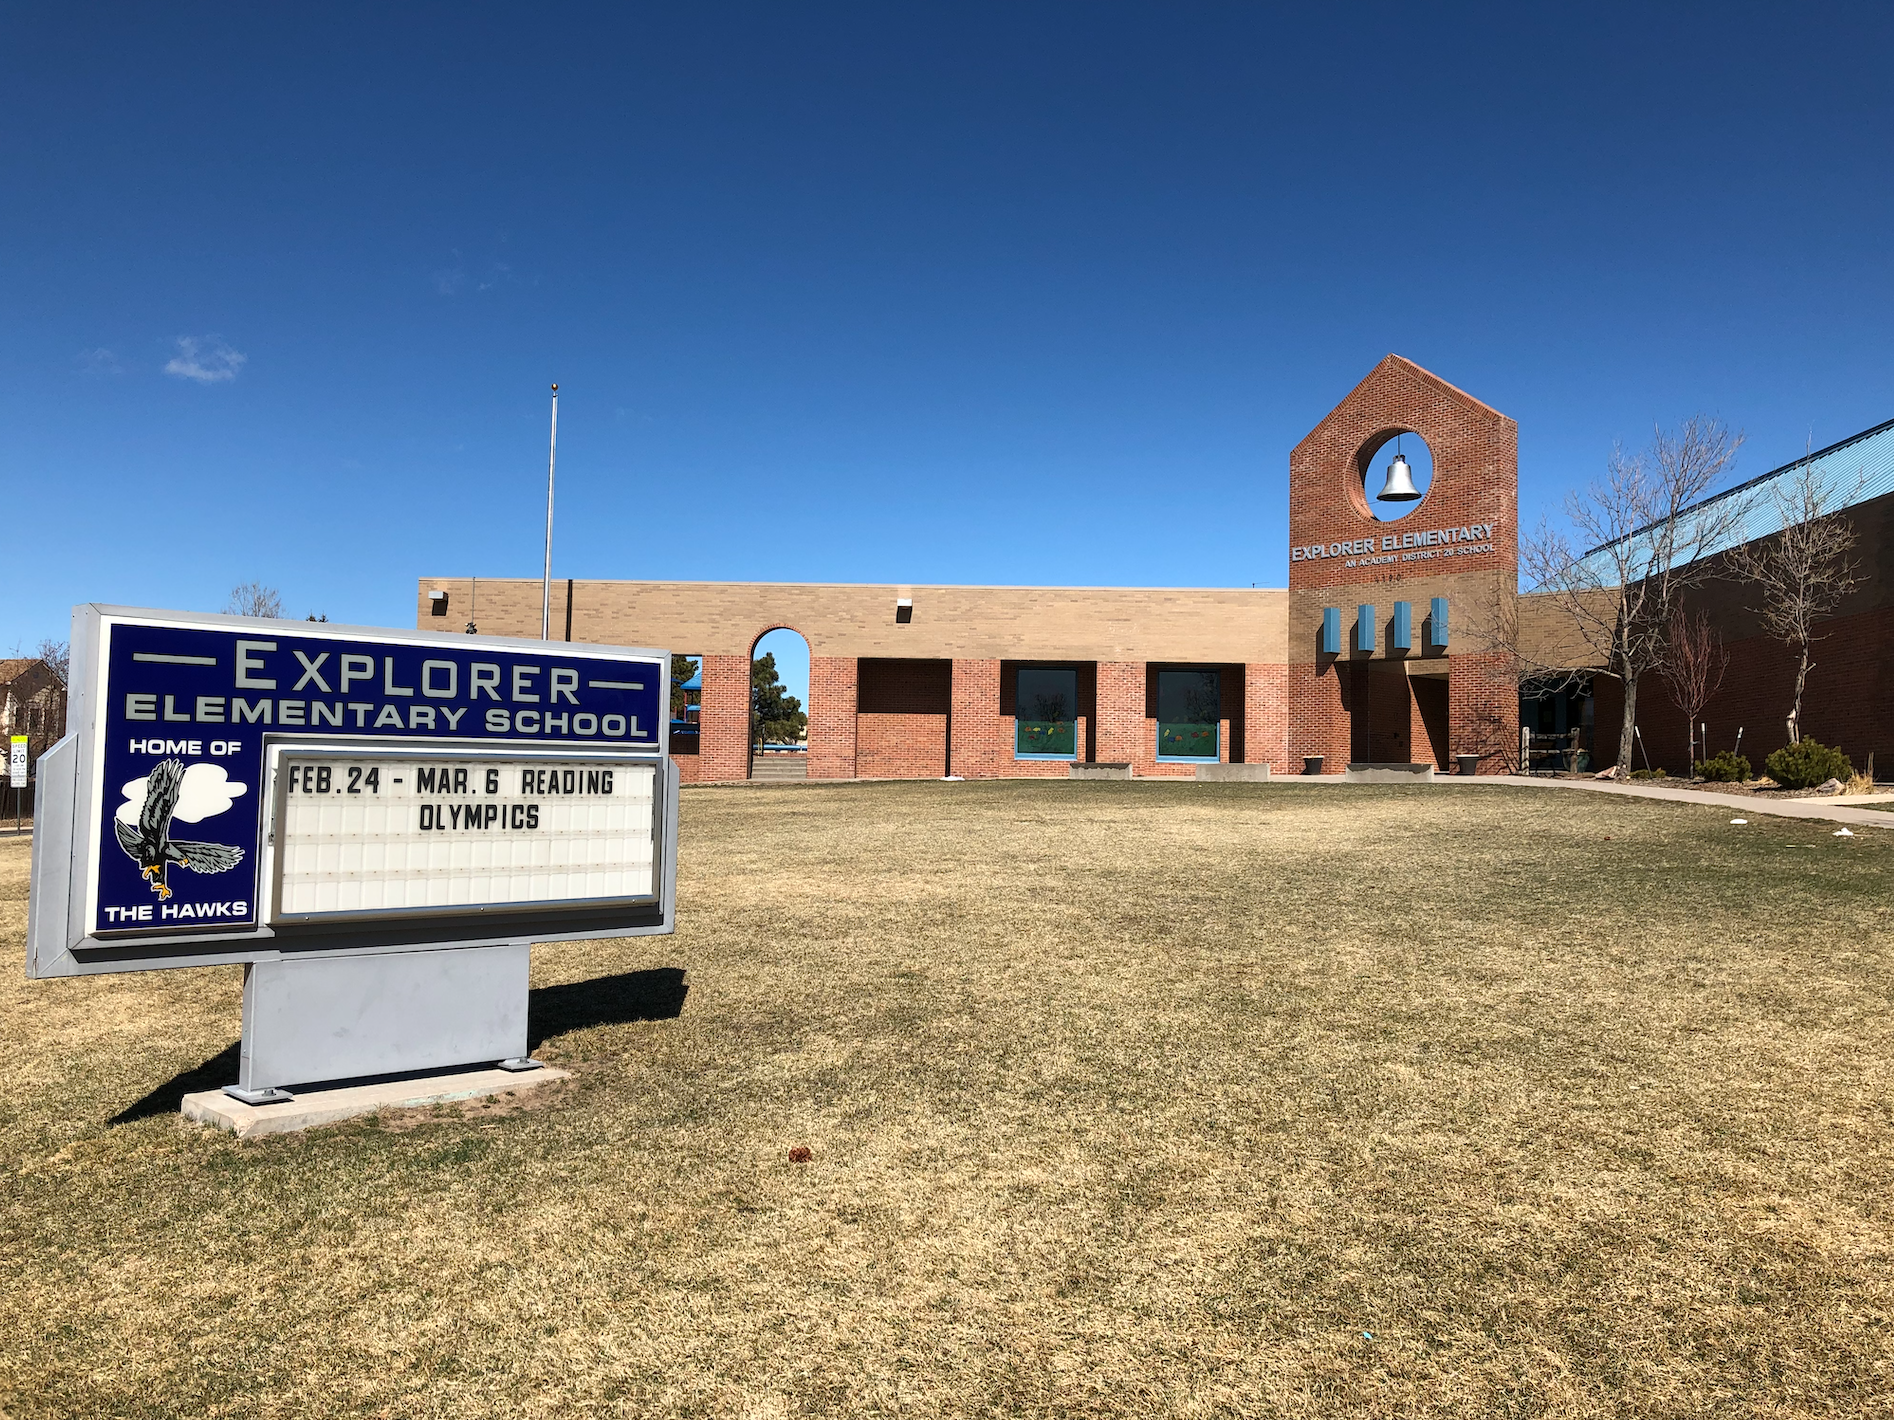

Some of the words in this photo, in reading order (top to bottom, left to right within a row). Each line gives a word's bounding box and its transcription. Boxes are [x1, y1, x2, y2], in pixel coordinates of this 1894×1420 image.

[1292, 538, 1375, 562] EXPLORER
[1382, 523, 1494, 551] ELEMENTARY
[1345, 560, 1356, 568] AN
[1359, 555, 1398, 567] ACADEMY
[1402, 549, 1438, 562] DISTRICT
[1443, 549, 1454, 558] 20
[1457, 543, 1495, 556] SCHOOL
[234, 640, 580, 706] EXPLORER
[125, 693, 467, 730] ELEMENTARY
[484, 709, 649, 738] SCHOOL
[12, 754, 26, 763] 20
[129, 738, 202, 755] HOME
[209, 740, 242, 756] OF
[521, 769, 614, 794] READING
[419, 804, 540, 830] OLYMPICS
[104, 905, 154, 921] THE
[161, 901, 247, 920] HAWKS
